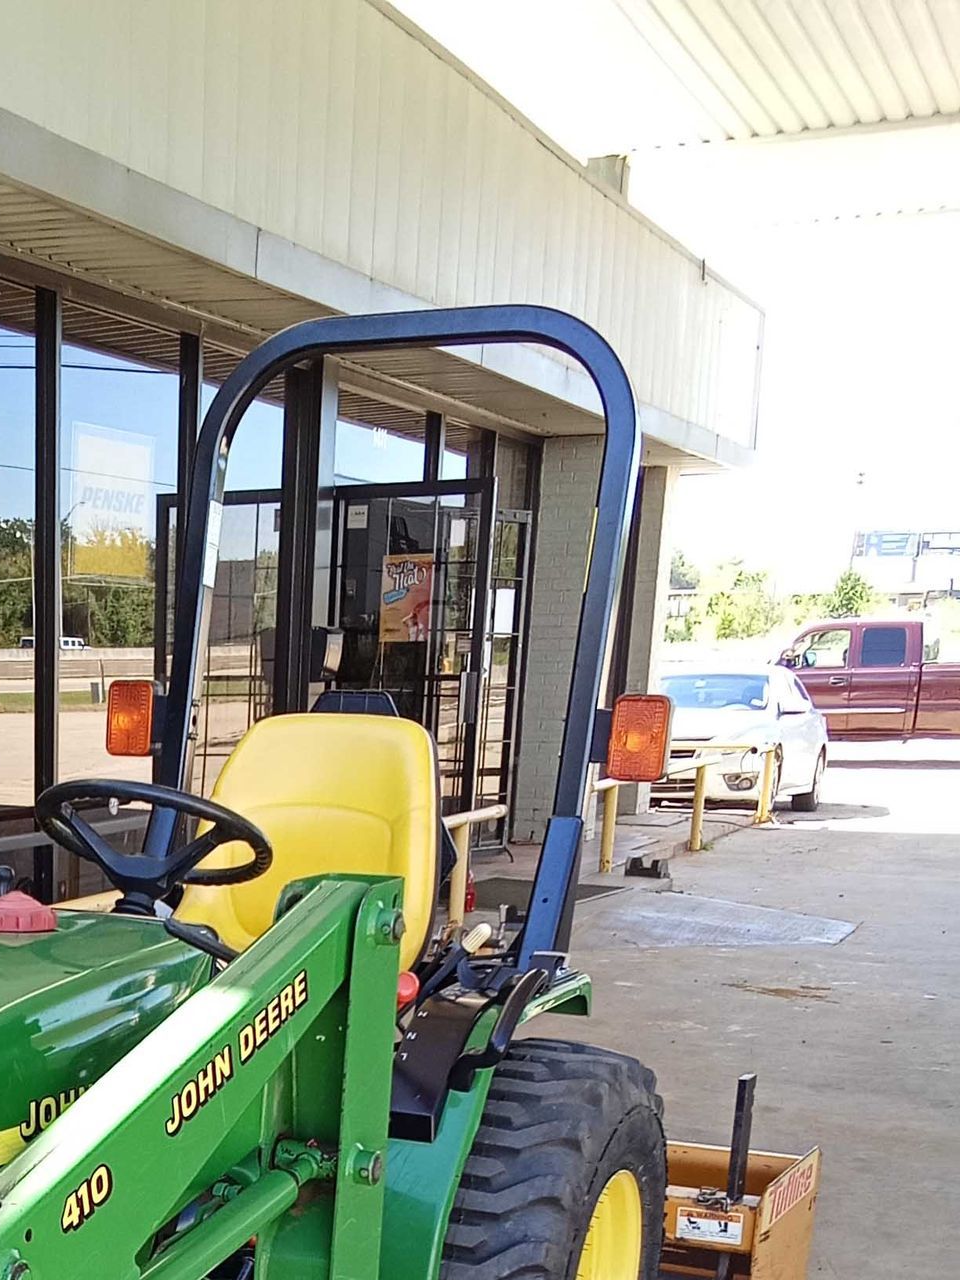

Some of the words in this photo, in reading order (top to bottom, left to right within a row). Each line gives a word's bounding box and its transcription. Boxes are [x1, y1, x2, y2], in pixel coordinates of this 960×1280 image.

[81, 486, 144, 514] PENSKE
[165, 1045, 233, 1137] JOHN
[239, 970, 307, 1065] DEERE
[19, 1083, 94, 1142] JOH
[60, 1163, 113, 1232] 410
